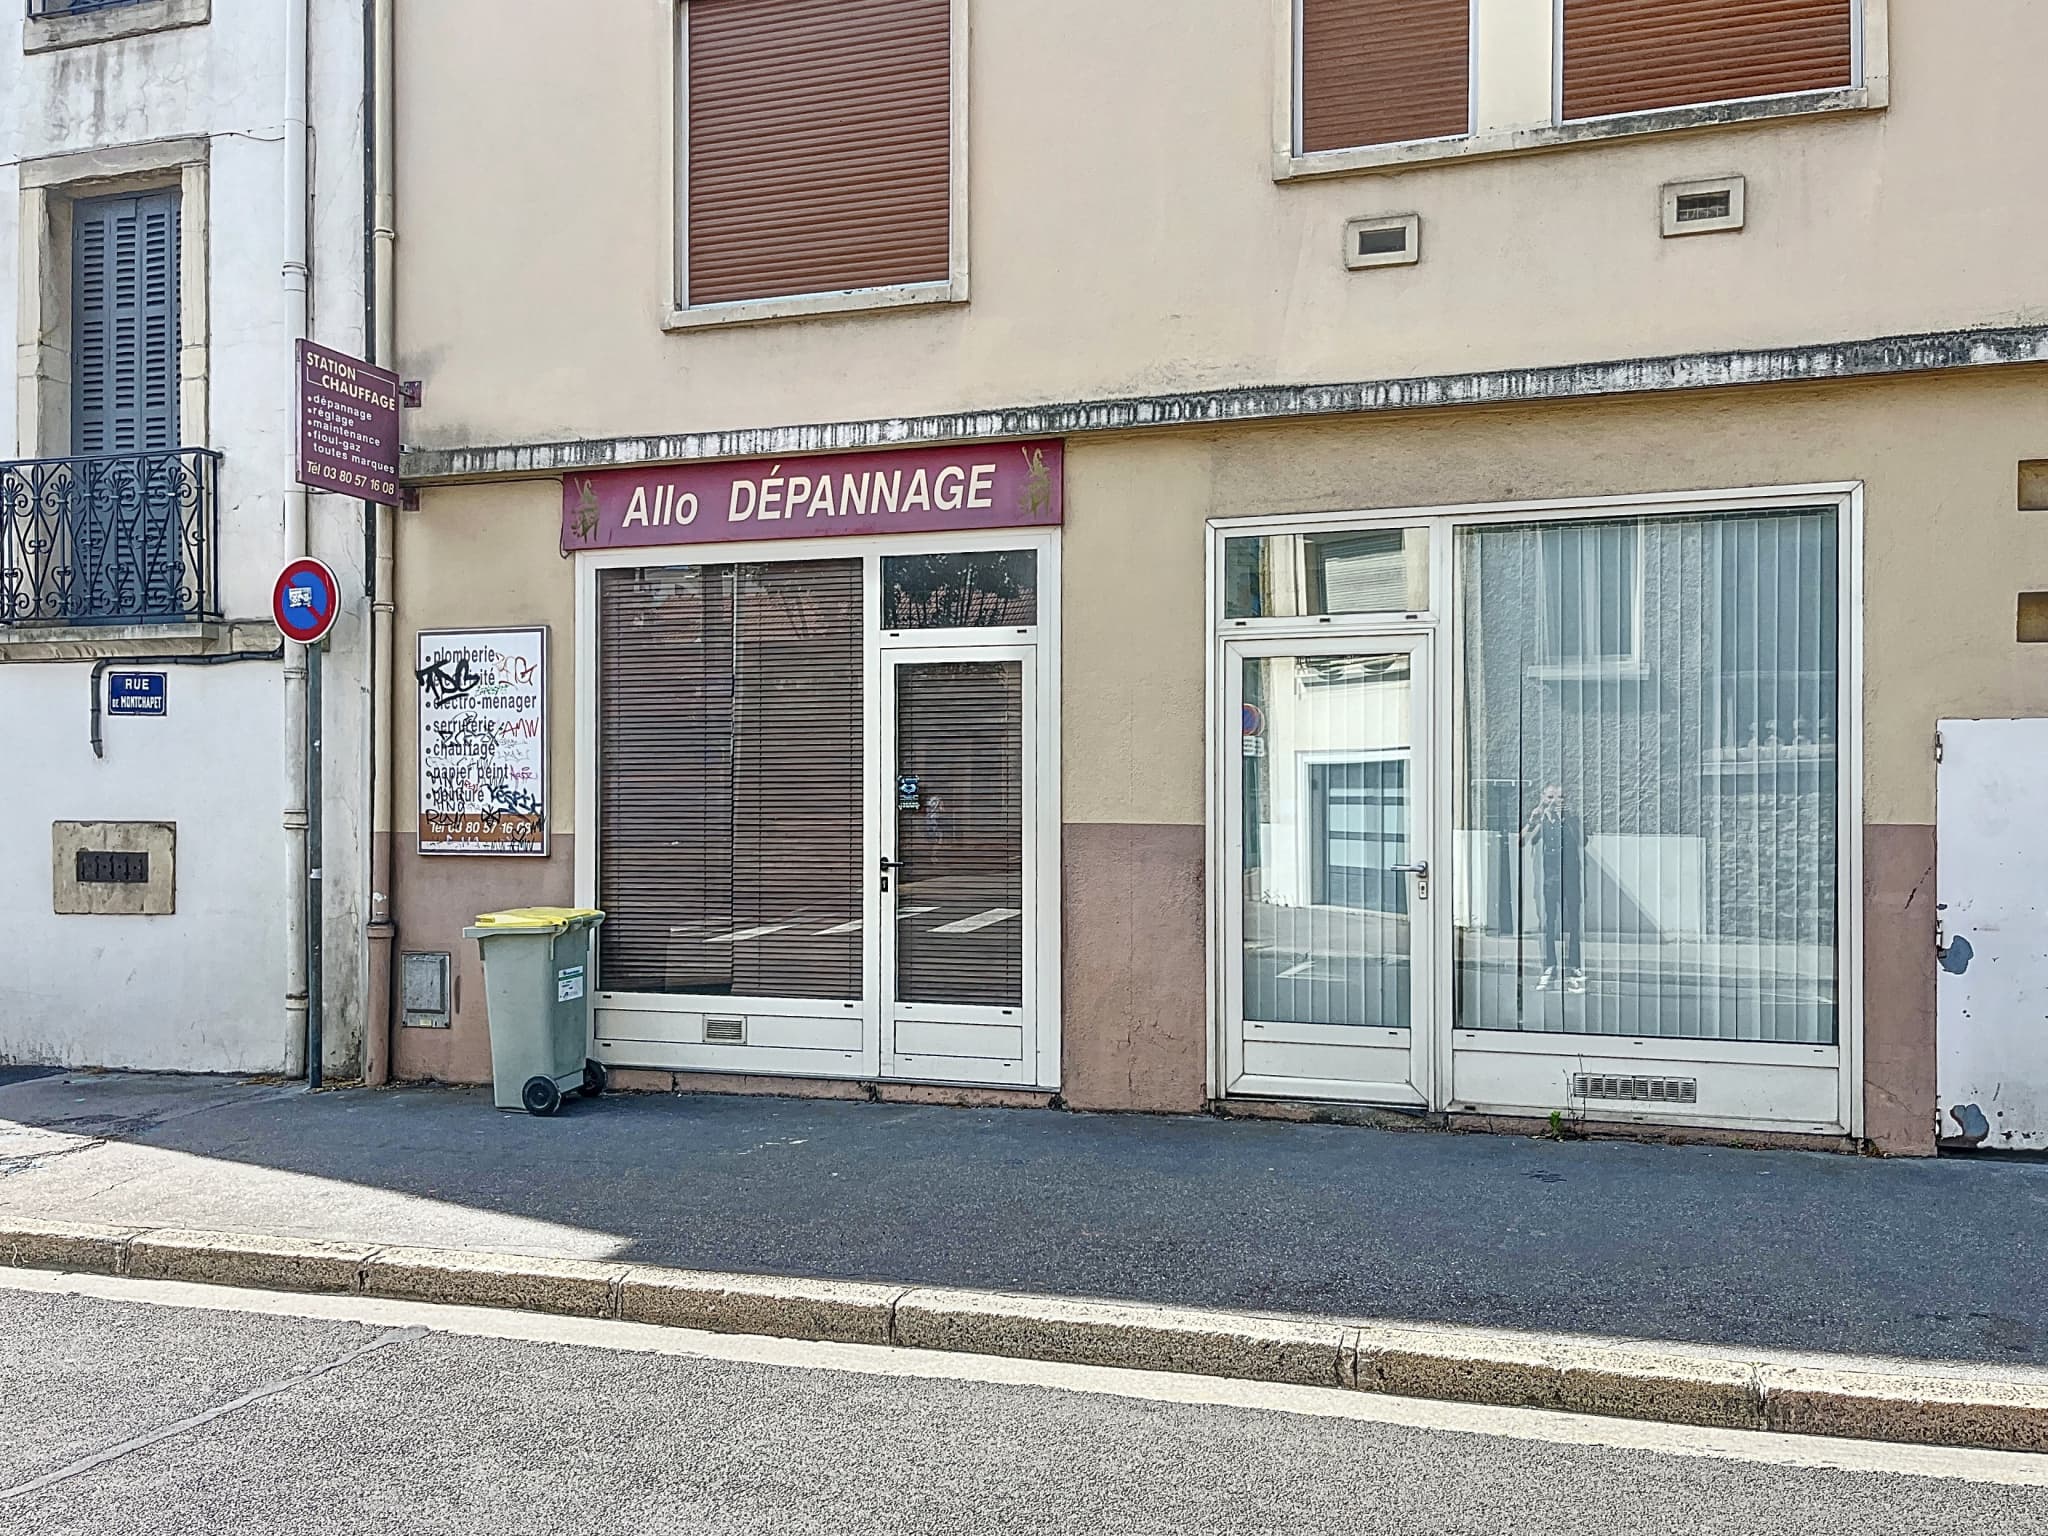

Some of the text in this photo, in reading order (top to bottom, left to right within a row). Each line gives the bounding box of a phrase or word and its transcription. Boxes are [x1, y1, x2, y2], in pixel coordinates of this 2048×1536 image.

[306, 351, 356, 381] STATION
[321, 375, 396, 411] CHAUFFAGE
[313, 394, 372, 421] dépannage
[313, 407, 354, 427] réglage
[313, 419, 381, 447] maintenance
[313, 431, 361, 453] fioul-gaz
[313, 443, 395, 474] toutes marques
[306, 460, 395, 495] Tél 03 80 57 16 08
[622, 463, 996, 528] Allo DÉPANNAGE
[434, 644, 495, 664] plomberie
[125, 678, 150, 690] RUE
[112, 696, 162, 709] DE MONTCHAPET
[433, 765, 472, 785] papier
[477, 762, 509, 785] peint
[465, 821, 480, 833] 80
[501, 822, 513, 834] 16
